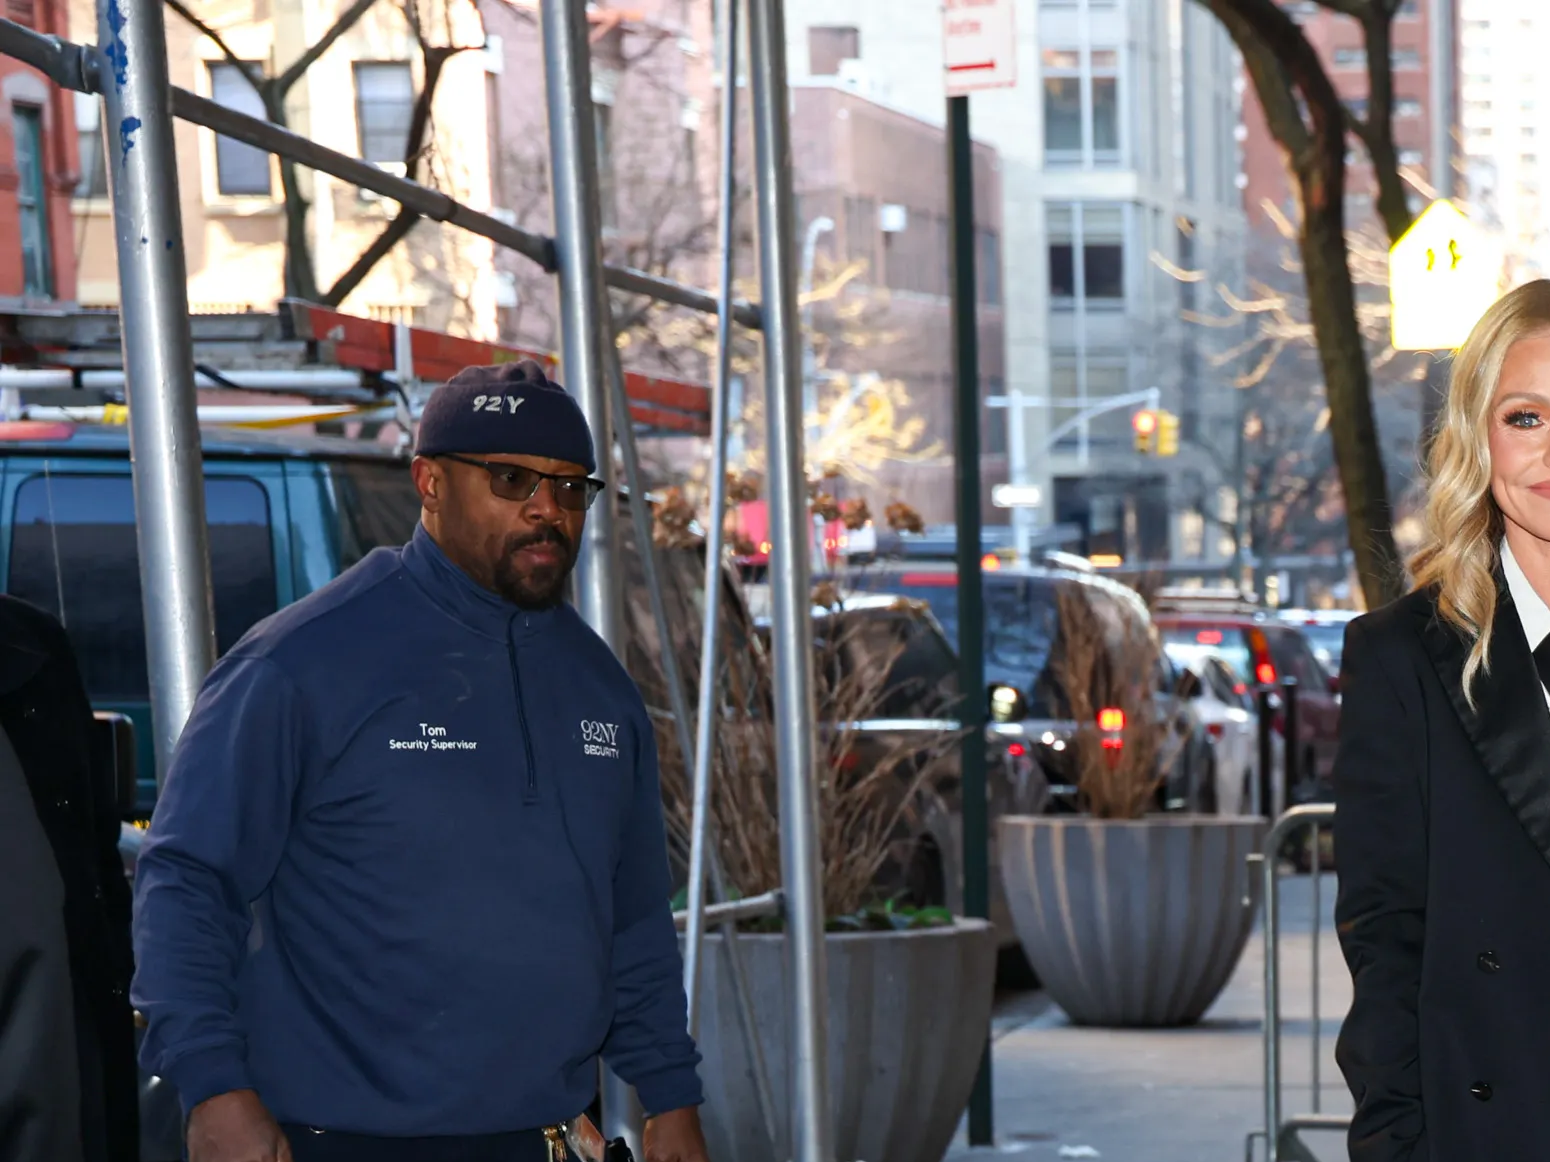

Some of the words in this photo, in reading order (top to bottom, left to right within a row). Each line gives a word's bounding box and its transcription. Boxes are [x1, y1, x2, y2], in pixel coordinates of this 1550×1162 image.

[419, 723, 447, 736] Tom
[581, 720, 619, 746] 92NY
[389, 739, 429, 751] Security
[431, 739, 477, 751] Supervisor
[584, 744, 619, 759] SECURITY
